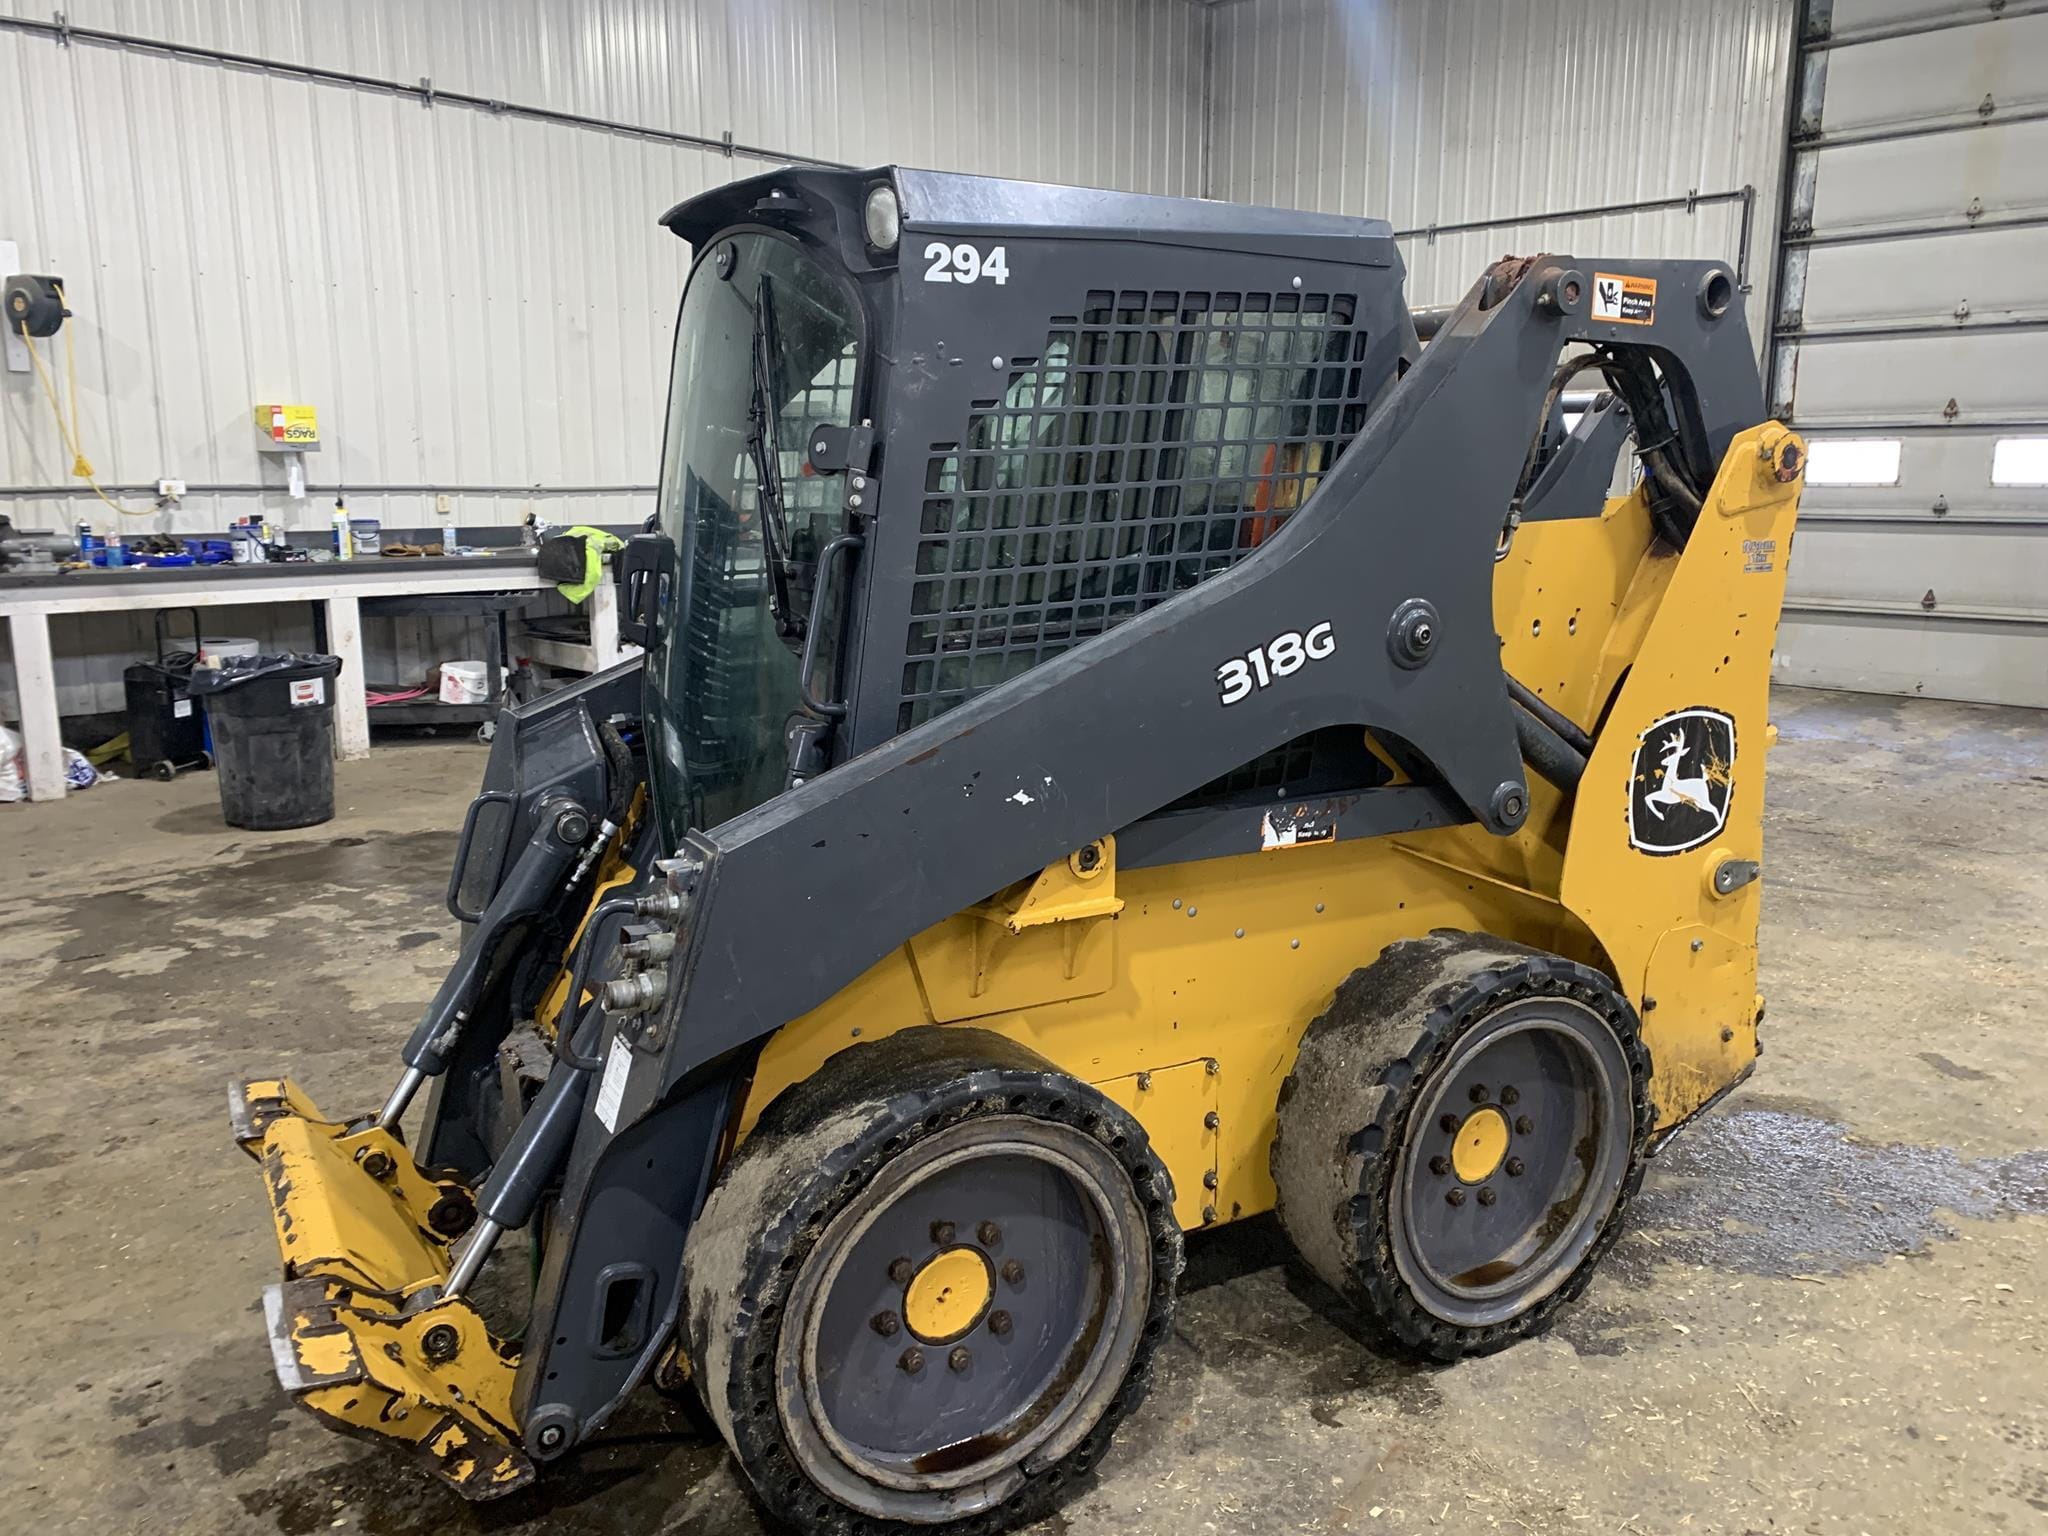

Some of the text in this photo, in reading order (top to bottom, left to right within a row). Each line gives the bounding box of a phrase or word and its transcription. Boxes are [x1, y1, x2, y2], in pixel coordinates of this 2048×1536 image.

[923, 242, 1010, 285] 294
[1623, 296, 1651, 307] Pinch Area
[286, 429, 316, 439] RAGS
[1215, 620, 1336, 706] 318G
